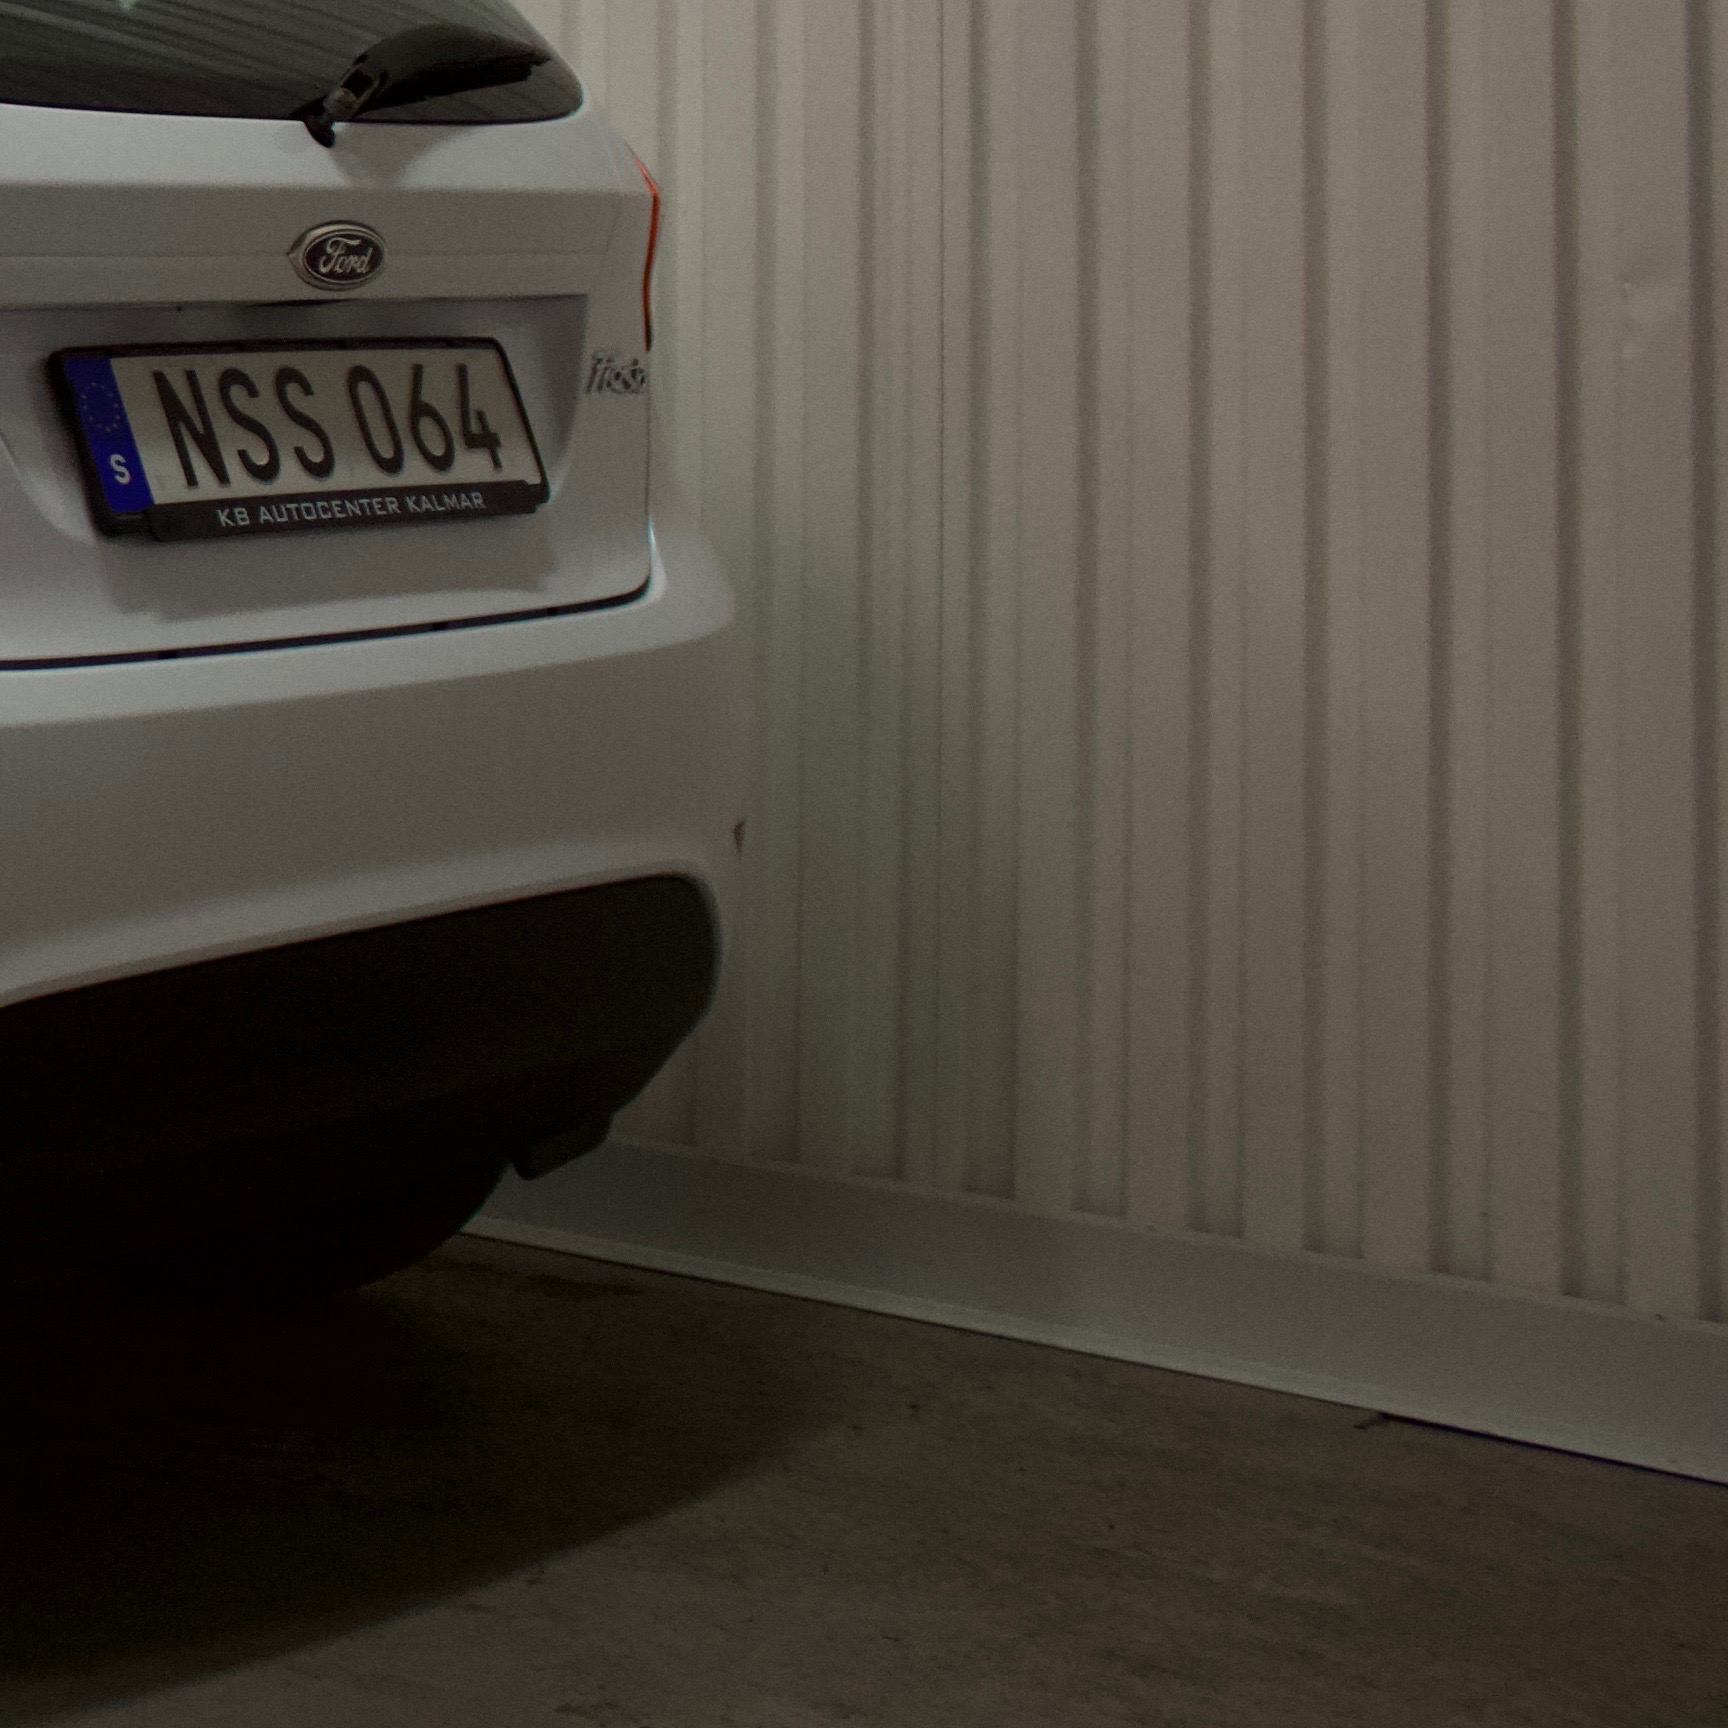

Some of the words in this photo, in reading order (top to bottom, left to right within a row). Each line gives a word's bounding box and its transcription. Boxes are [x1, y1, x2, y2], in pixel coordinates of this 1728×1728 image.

[319, 236, 374, 274] Ford
[152, 365, 336, 489] NSS
[348, 362, 503, 476] 064
[109, 453, 132, 485] S
[217, 507, 250, 528] KB
[259, 497, 402, 525] AUTOCENTER
[405, 491, 487, 514] KALMAR
